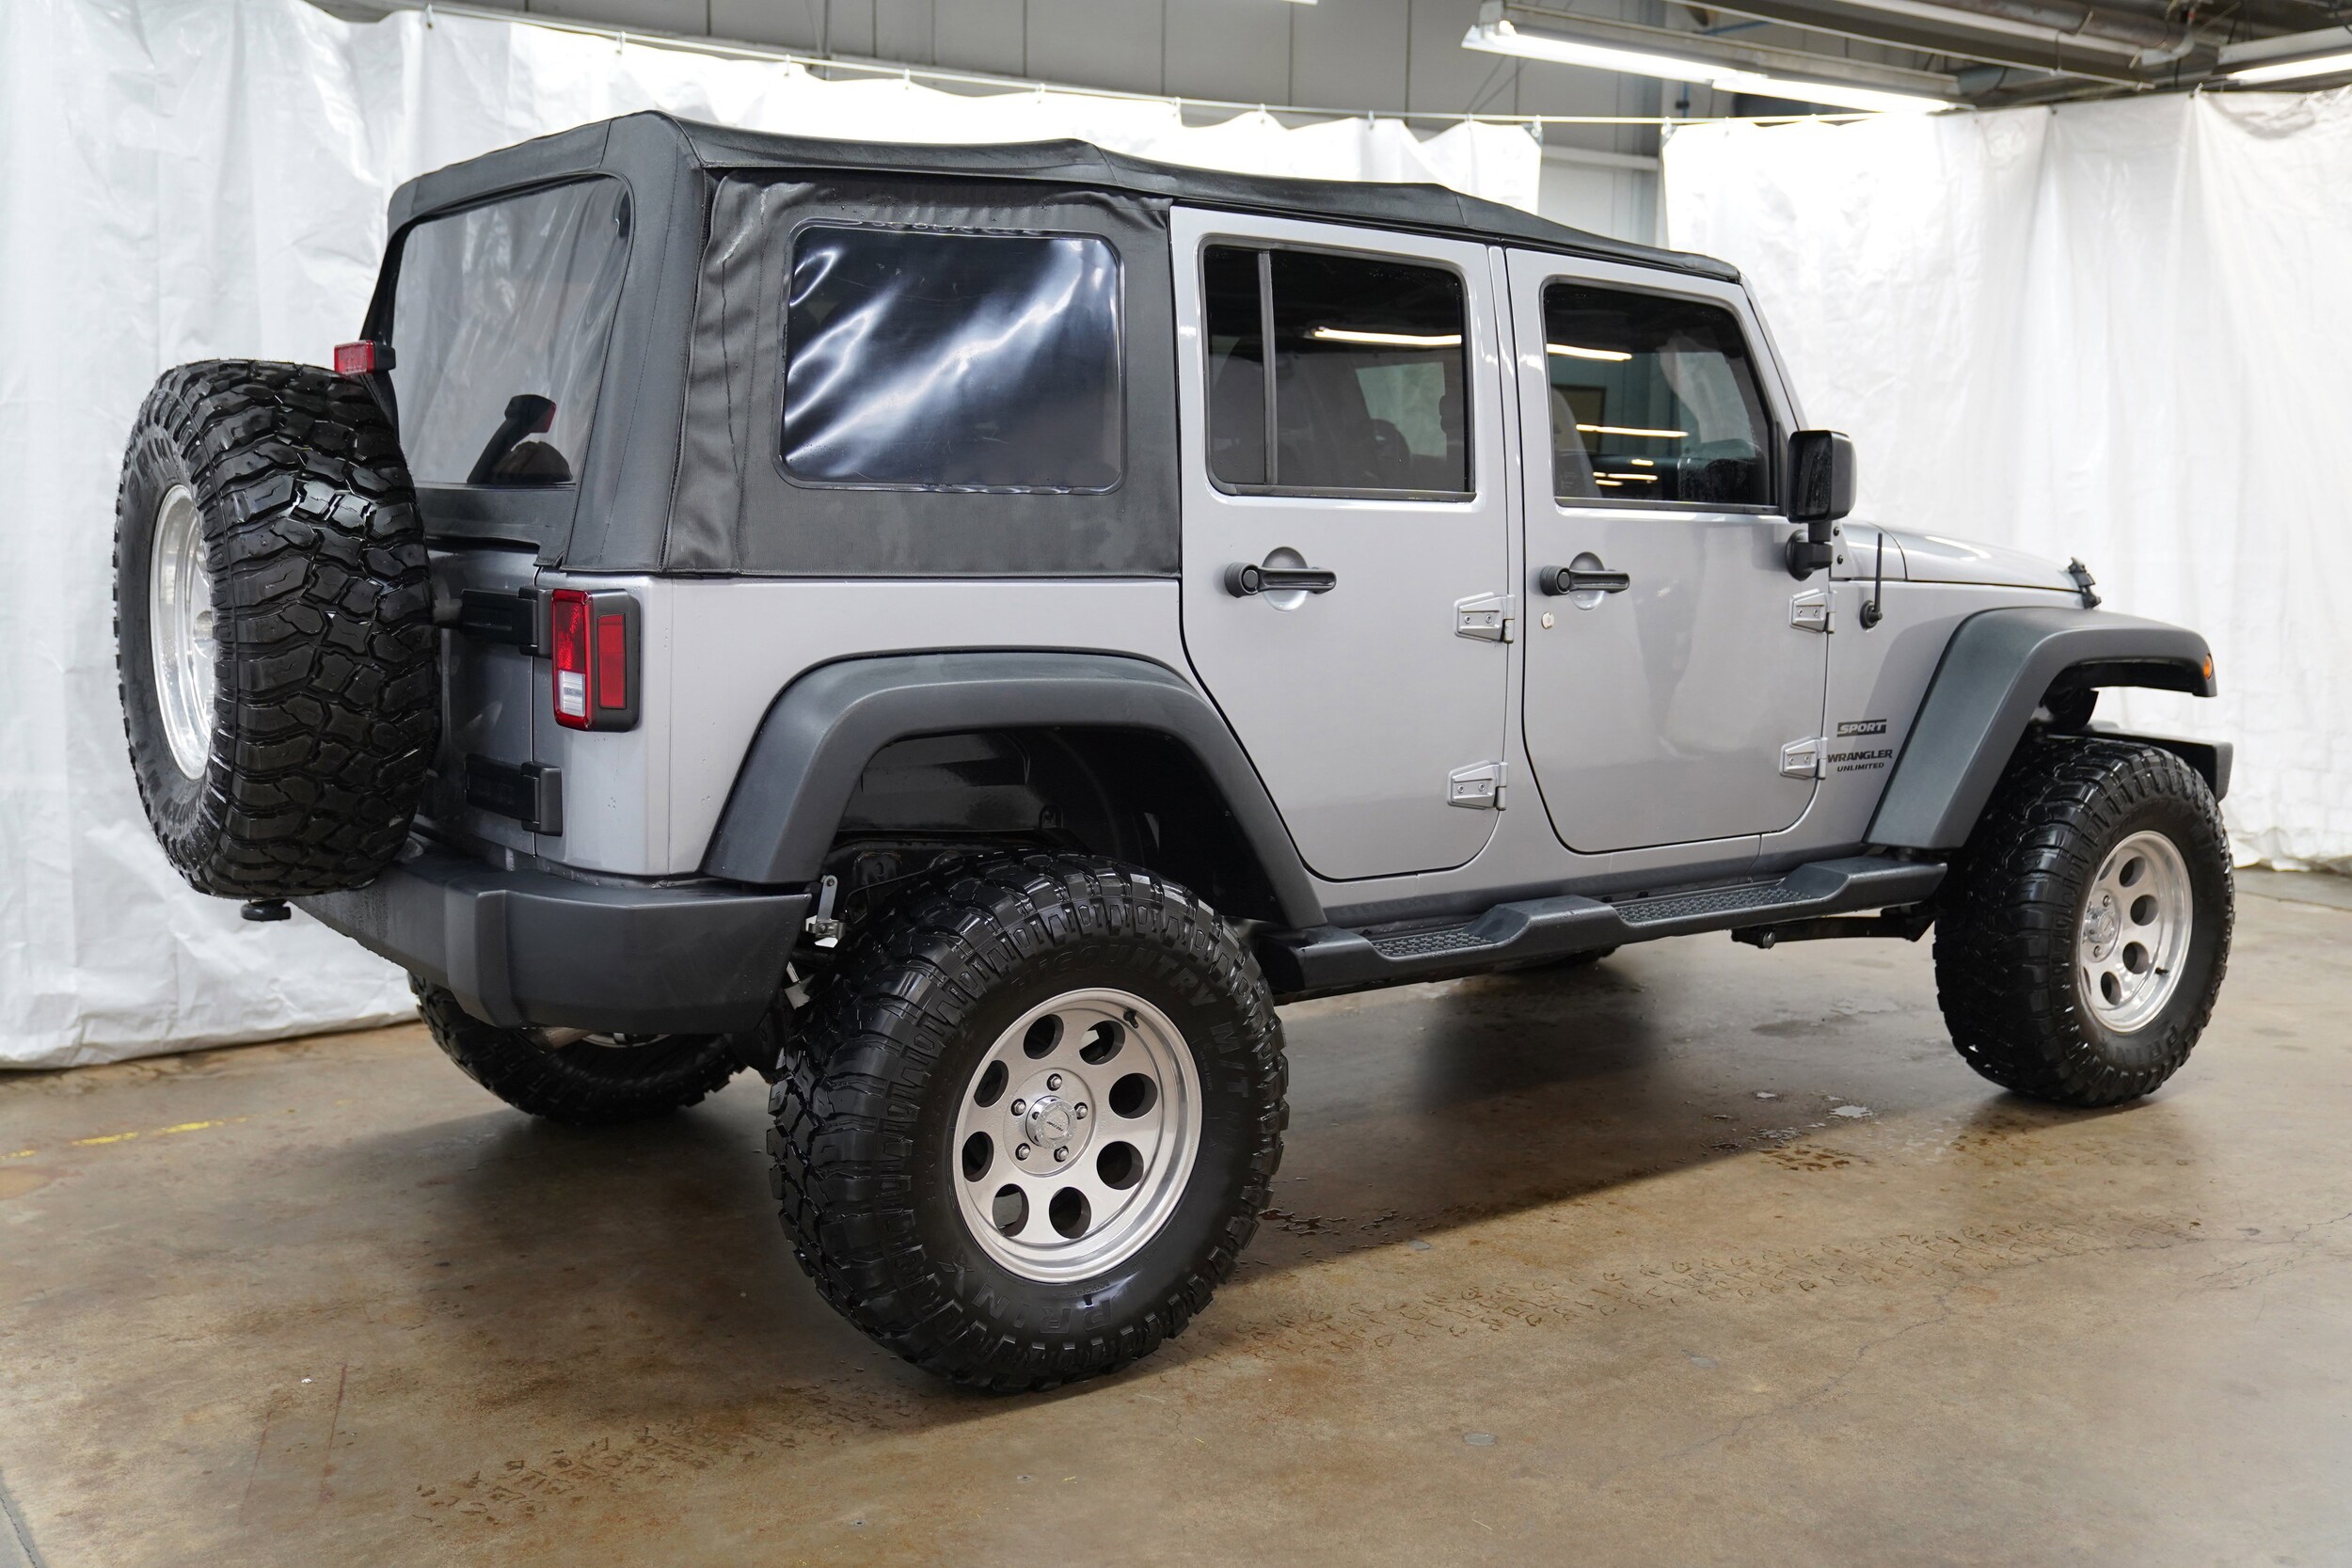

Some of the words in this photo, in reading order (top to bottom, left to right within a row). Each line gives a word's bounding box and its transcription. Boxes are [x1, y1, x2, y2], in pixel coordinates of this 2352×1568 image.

[1838, 721, 1885, 735] SPORT
[1827, 749, 1893, 763] WRANGLER
[1837, 762, 1884, 772] UNLIMITED
[1210, 1021, 1249, 1099] M/T
[937, 1254, 1113, 1334] PRINX
